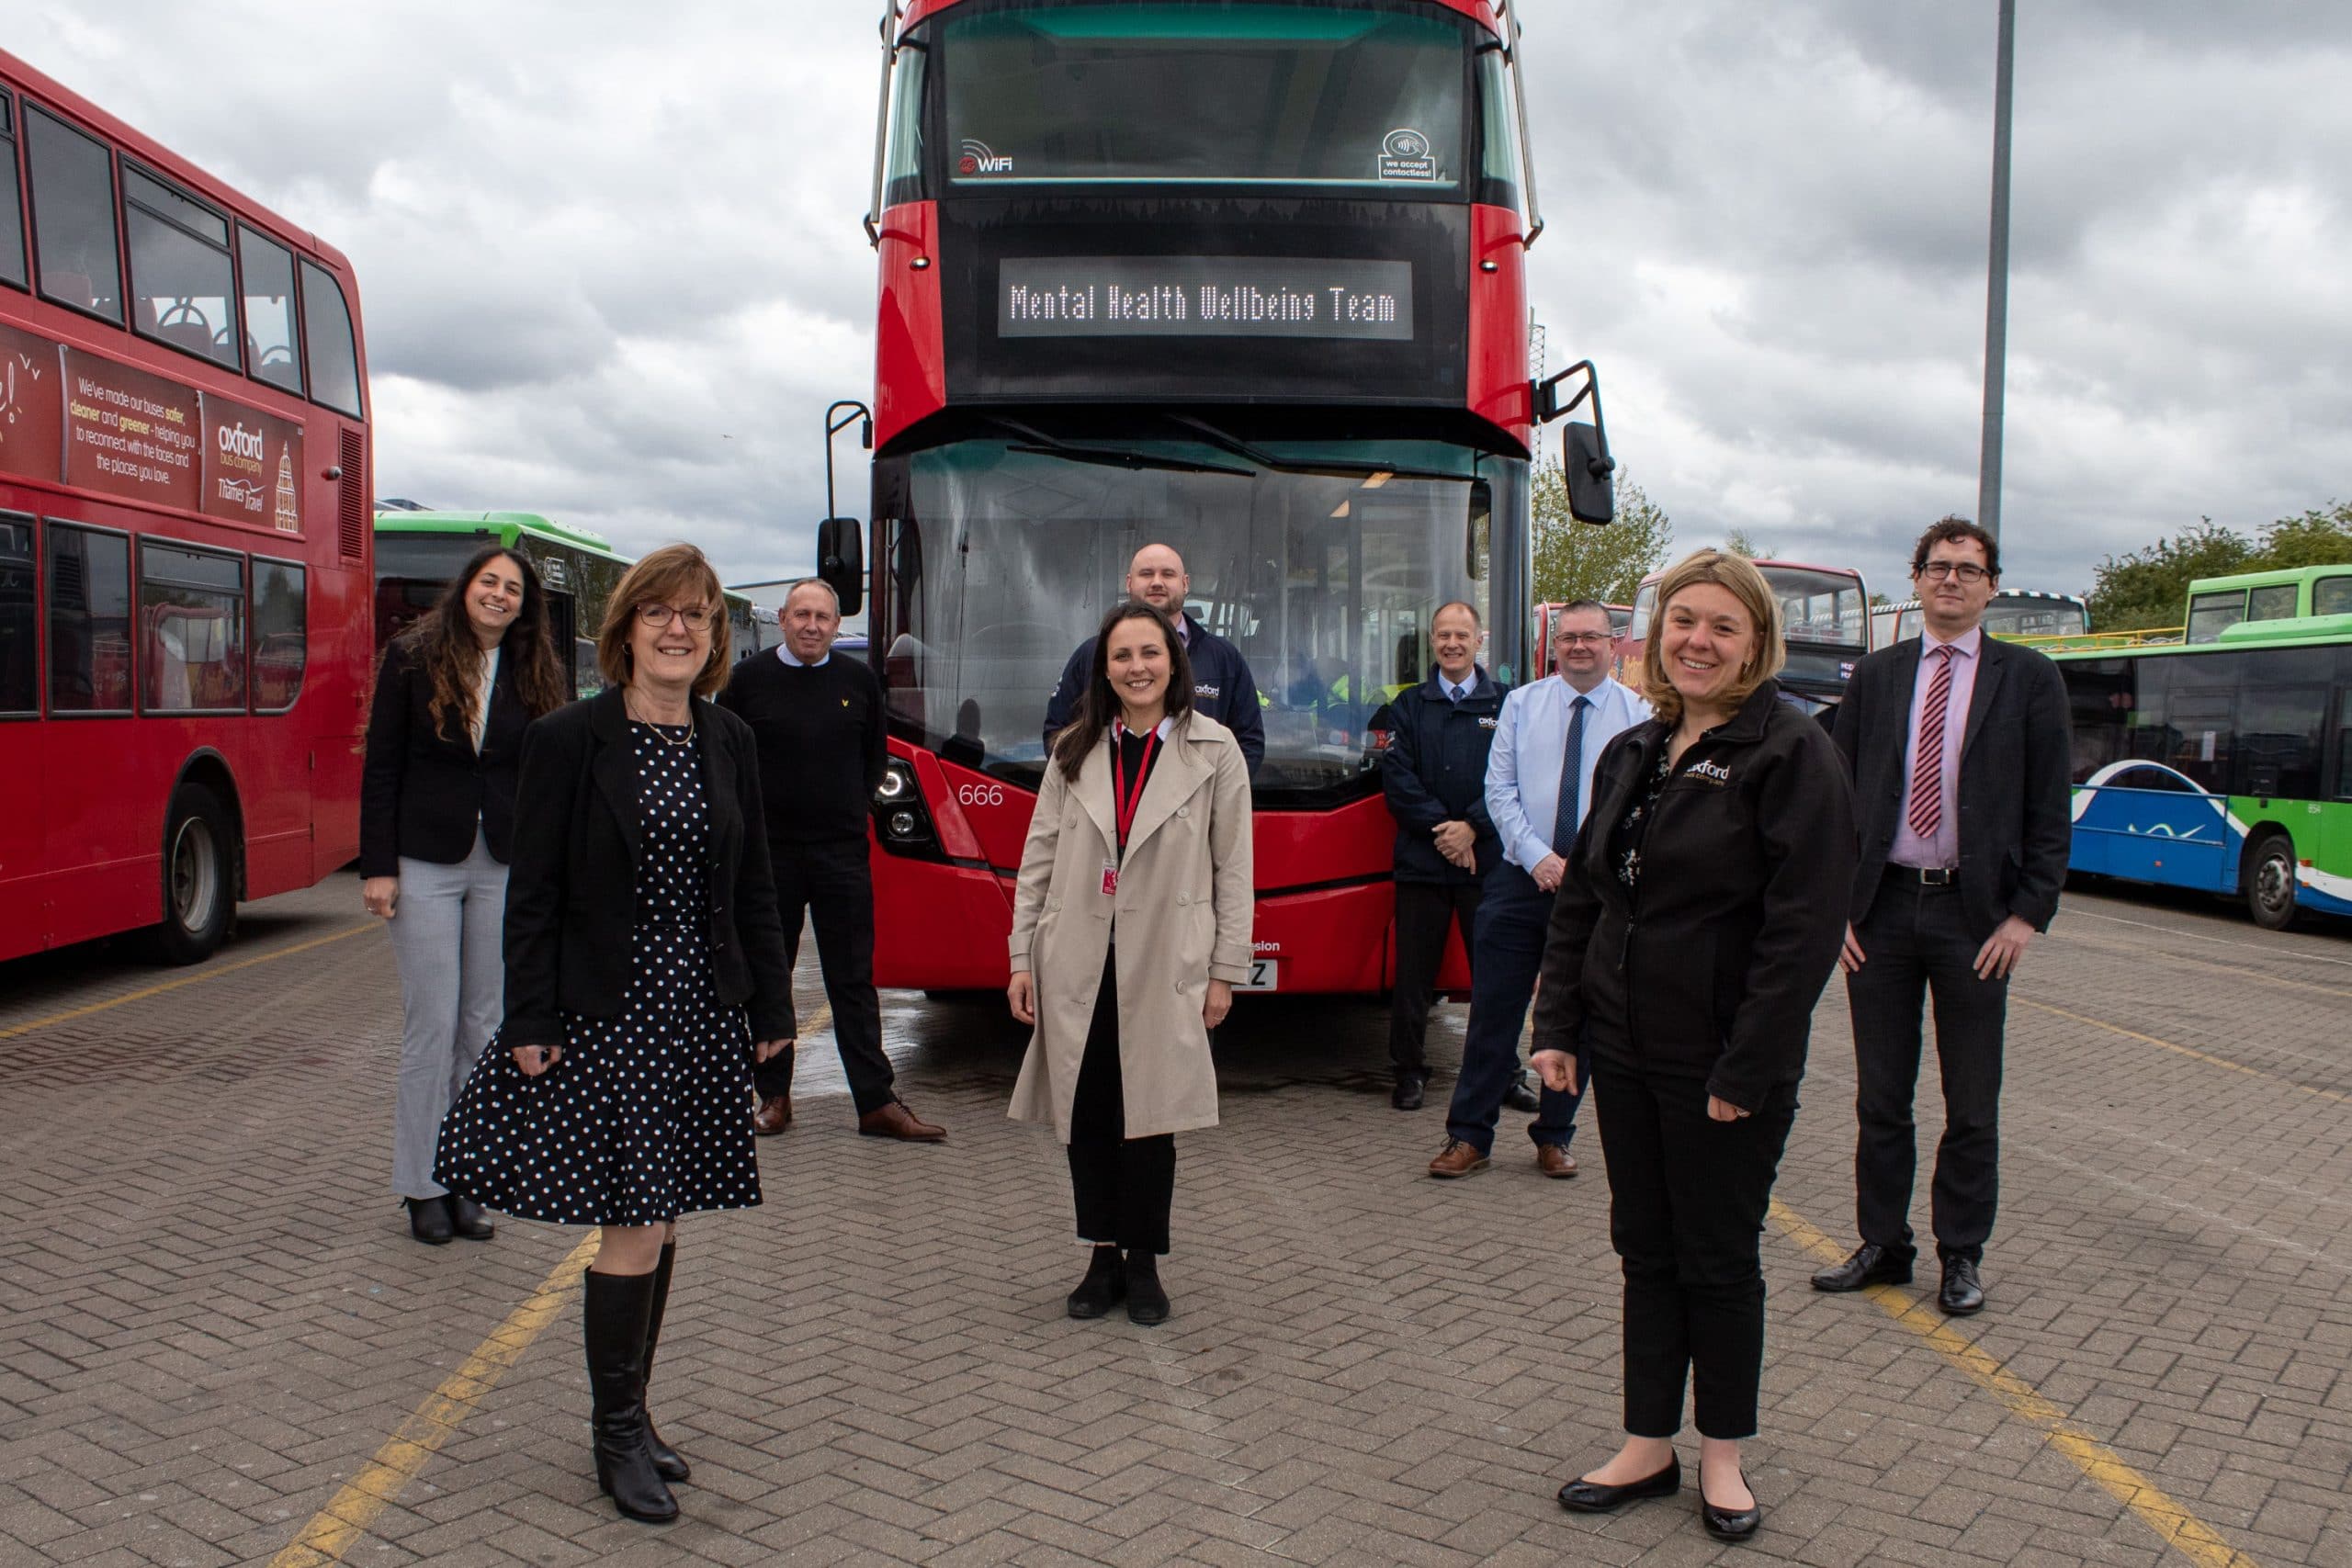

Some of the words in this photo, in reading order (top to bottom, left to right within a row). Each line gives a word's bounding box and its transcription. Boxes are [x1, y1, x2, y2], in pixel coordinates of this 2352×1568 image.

[978, 157, 1012, 172] WiFi
[1011, 285, 1094, 320] Mental
[1108, 285, 1186, 320] Health
[1201, 286, 1315, 321] Wellbeing
[1329, 287, 1396, 321] Team
[78, 377, 104, 400] We've
[106, 389, 129, 408] made
[130, 397, 142, 412] our
[144, 397, 164, 419] buses
[70, 399, 100, 422] cleaner
[101, 411, 118, 427] and
[119, 416, 150, 434] greener
[154, 423, 180, 448] helping
[181, 434, 196, 449] you
[76, 425, 85, 441] to
[85, 430, 127, 452] reconnect
[127, 439, 142, 456] with
[142, 442, 154, 459] the
[155, 445, 175, 465] faces
[175, 453, 189, 468] and
[218, 422, 264, 461] oxford
[96, 453, 110, 470] the
[111, 457, 138, 477] places
[139, 466, 153, 482] you
[220, 452, 233, 467] bus
[233, 456, 264, 478] company
[218, 478, 244, 502] Thames
[245, 491, 265, 513] Travel
[1194, 684, 1220, 696] oxford
[1478, 716, 1498, 727] oxfo
[959, 784, 1003, 806] 666
[1254, 941, 1280, 952] sion
